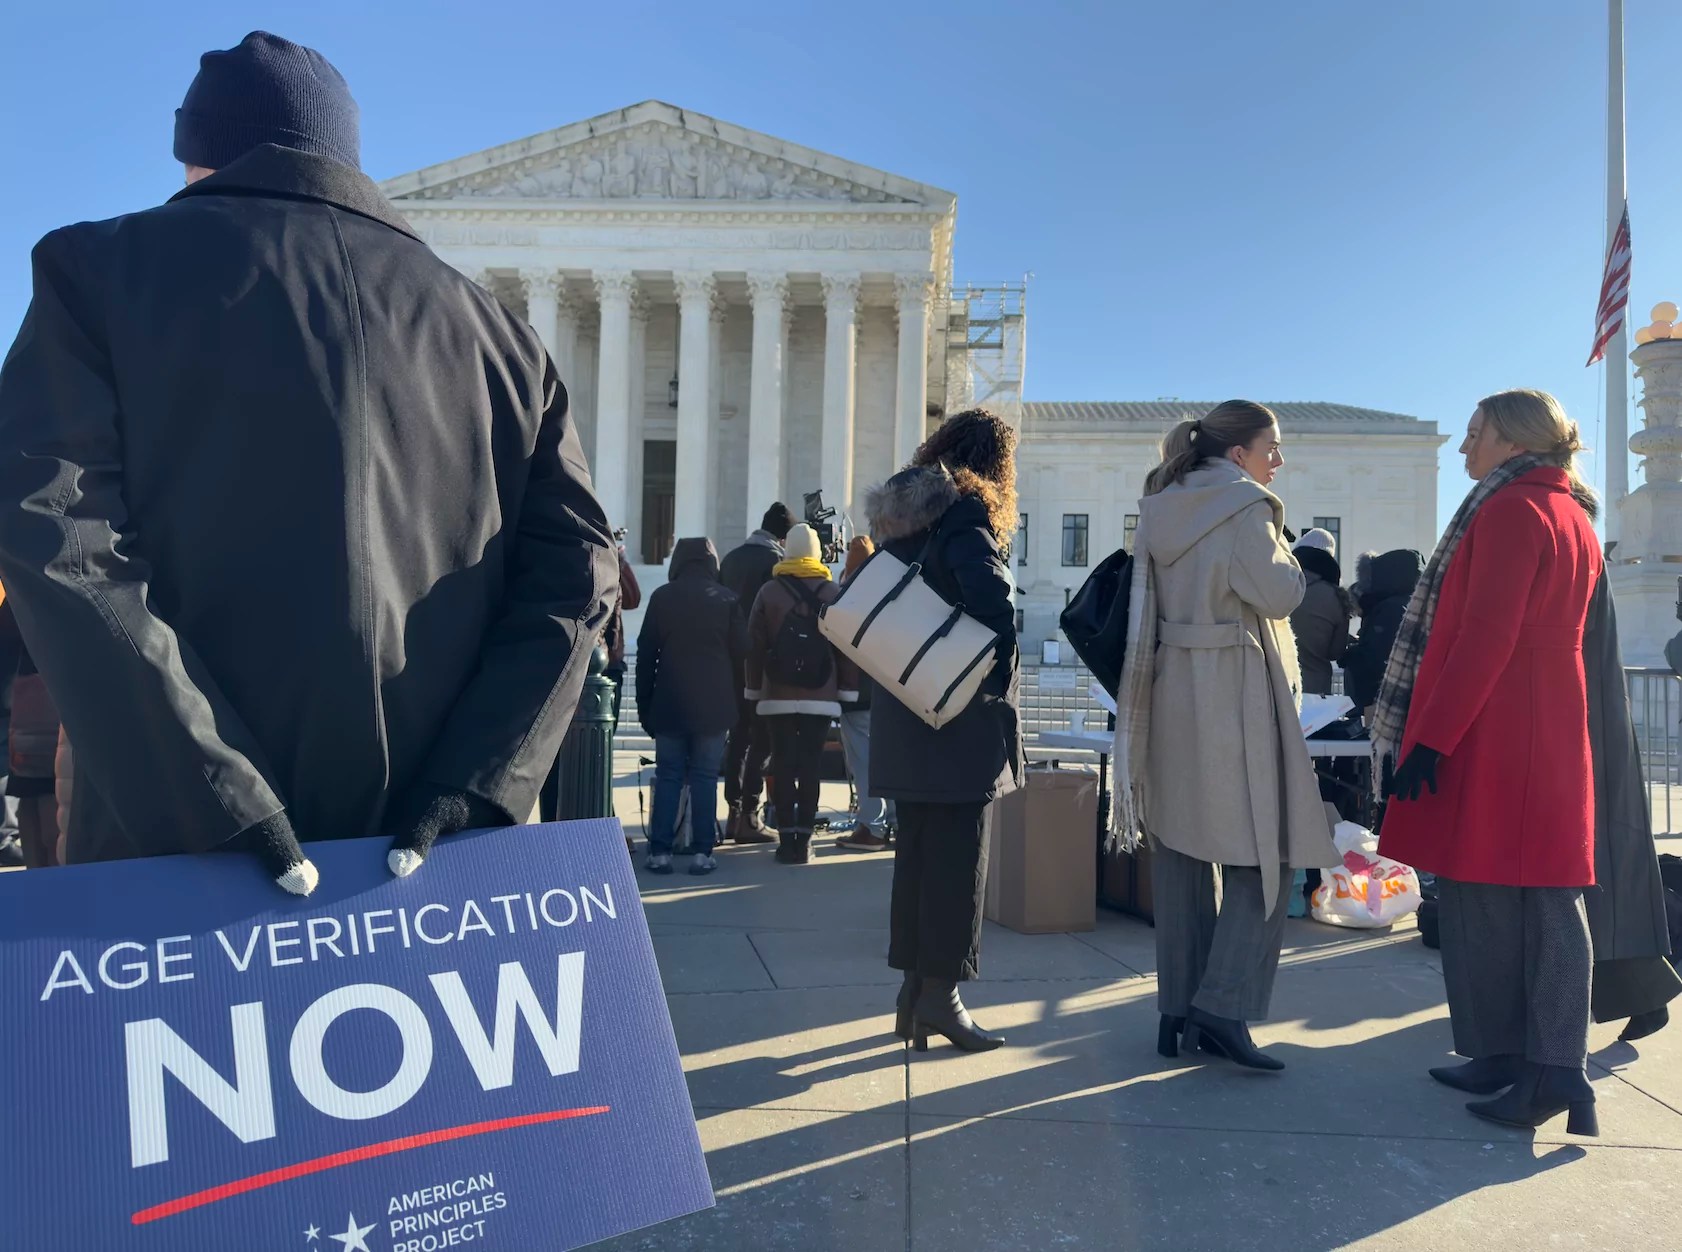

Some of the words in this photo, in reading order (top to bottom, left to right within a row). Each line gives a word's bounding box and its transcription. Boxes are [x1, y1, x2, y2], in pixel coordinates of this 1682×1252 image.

[40, 936, 194, 1001] AGE
[214, 883, 617, 972] VERIFICATION
[124, 951, 586, 1168] NOW
[388, 1172, 494, 1215] AMERICAN
[390, 1192, 506, 1237] PRINCIPLES
[394, 1220, 485, 1252] PROJECT
